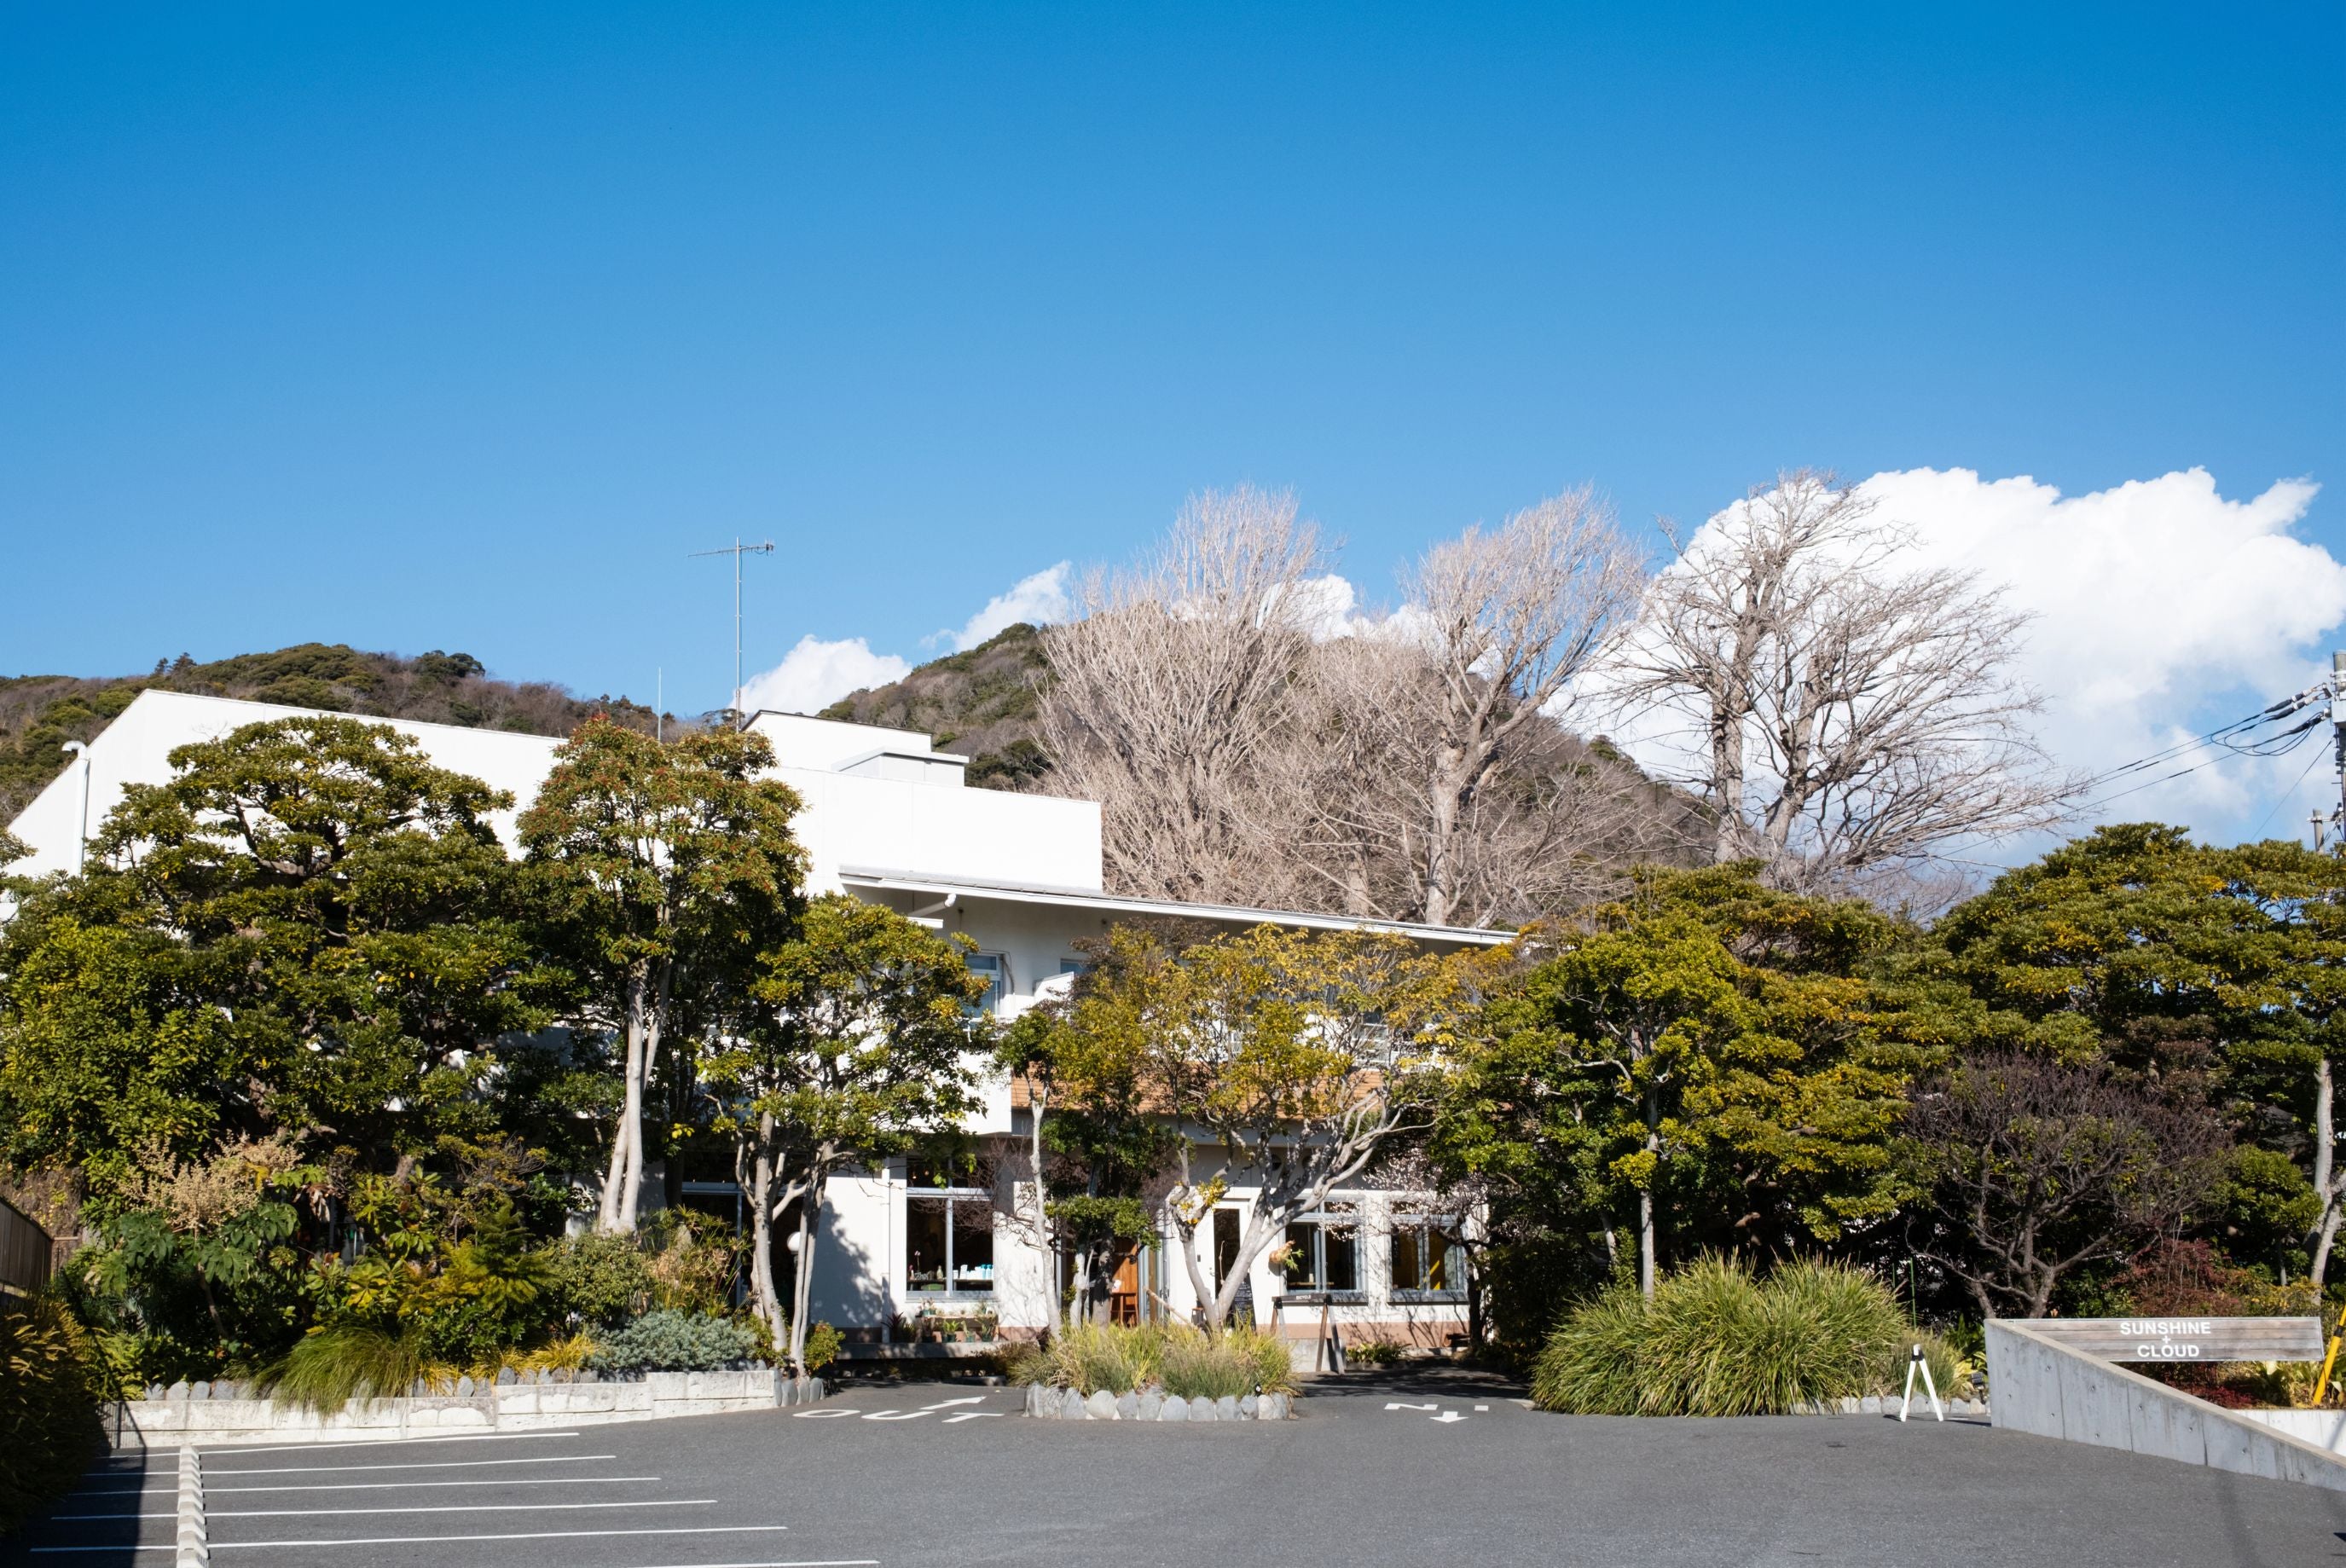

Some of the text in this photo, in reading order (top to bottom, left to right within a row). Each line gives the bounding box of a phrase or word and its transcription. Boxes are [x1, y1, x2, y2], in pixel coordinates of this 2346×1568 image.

[2119, 1322, 2211, 1335] SUNSHINE
[2137, 1344, 2200, 1357] CLOUD
[792, 1409, 1005, 1423] OUT
